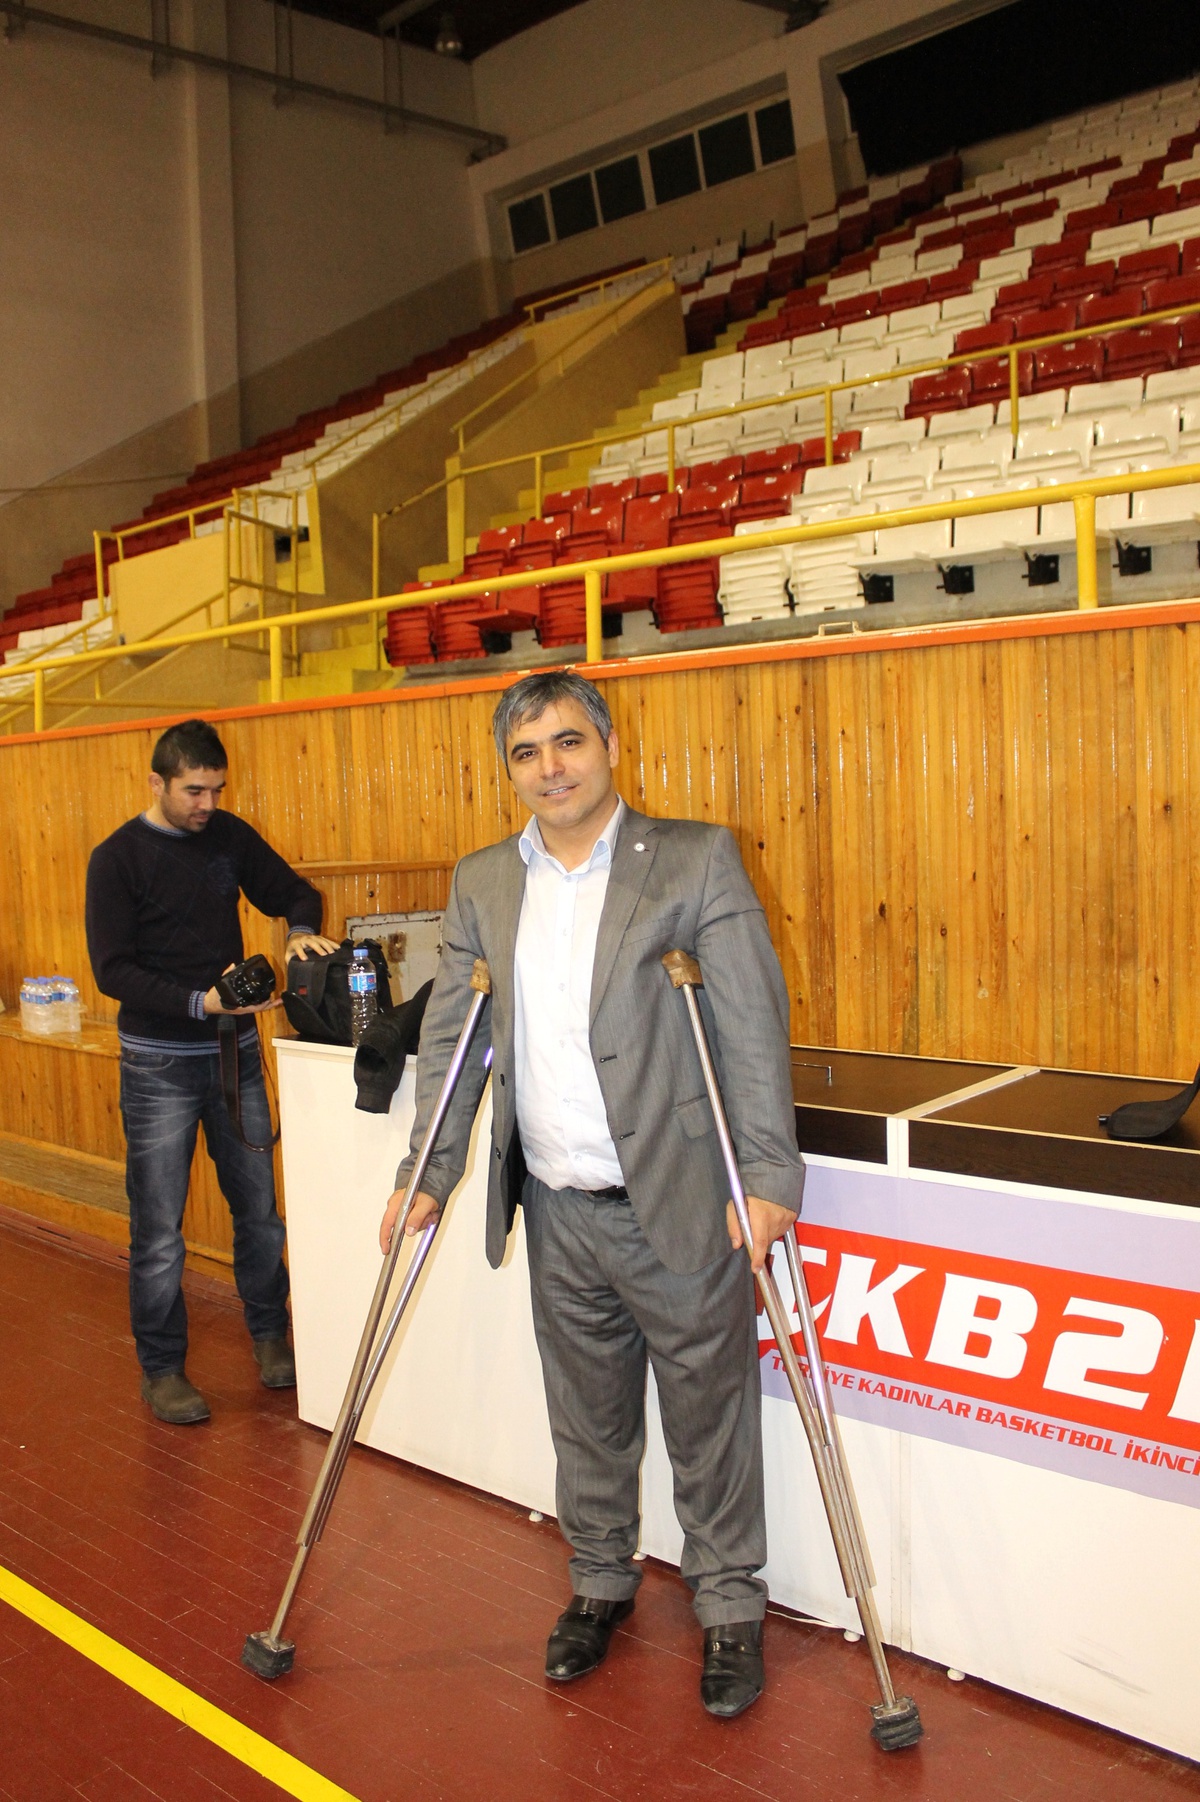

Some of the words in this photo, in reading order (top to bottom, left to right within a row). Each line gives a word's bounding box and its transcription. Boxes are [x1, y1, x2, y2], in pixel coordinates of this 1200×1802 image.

[757, 1241, 1200, 1423] KB2
[771, 1356, 855, 1389] TRİYE
[857, 1378, 971, 1418] KADINLAR
[975, 1407, 1117, 1456] BASKETBOL
